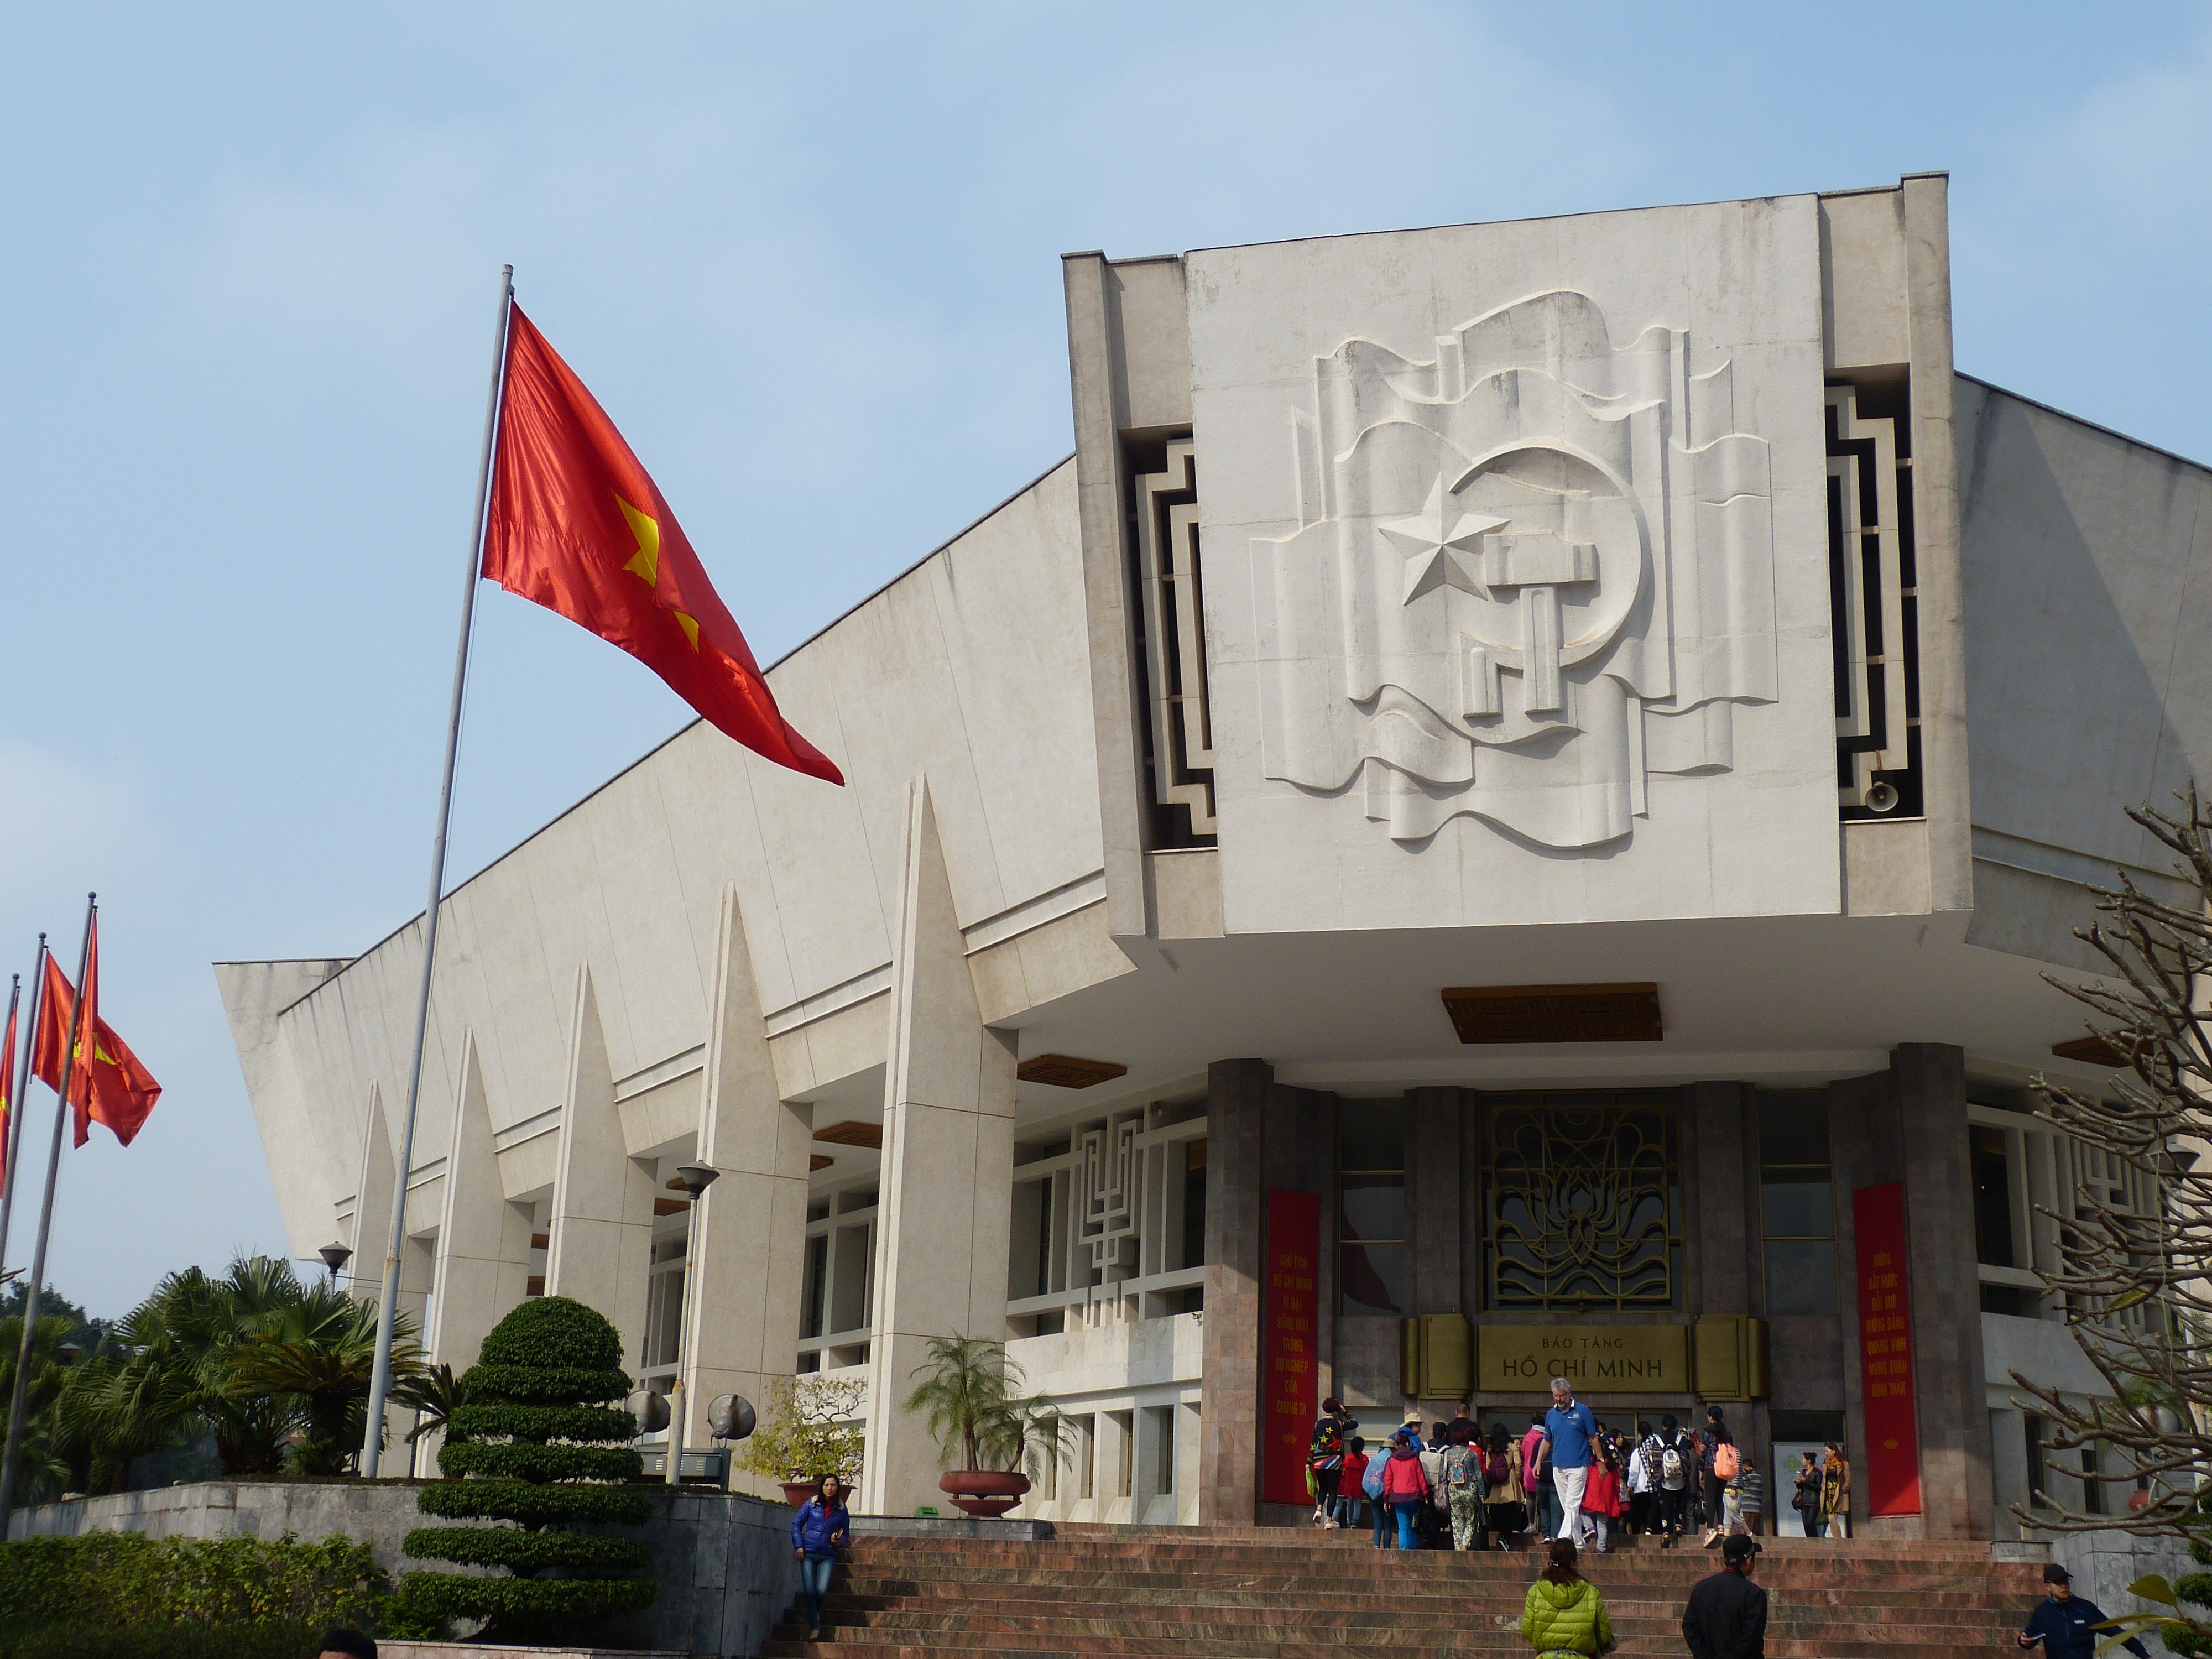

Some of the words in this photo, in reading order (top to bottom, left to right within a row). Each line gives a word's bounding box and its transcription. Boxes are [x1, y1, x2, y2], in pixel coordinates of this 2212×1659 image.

[1873, 1250, 1892, 1267] MỪNG
[1273, 1270, 1282, 1287] HỒ
[1284, 1273, 1295, 1289] CHÍ
[1296, 1276, 1313, 1291] MINH
[1282, 1336, 1303, 1353] TRONG
[1542, 1335, 1572, 1348] BẢO
[1580, 1335, 1623, 1349] TÀNG
[1867, 1339, 1889, 1357] QUANG
[1891, 1337, 1907, 1352] VINH
[1275, 1357, 1285, 1374] SỰ
[1285, 1358, 1309, 1376] NGHIỆP
[1503, 1354, 1538, 1378] HỒ
[1547, 1355, 1587, 1378] CHÍ
[1597, 1359, 1662, 1378] MINH
[1889, 1357, 1907, 1374] XUÂN
[1285, 1375, 1298, 1394] CỦA
[1276, 1398, 1298, 1415] CHÚNG
[1299, 1402, 1307, 1416] TA
